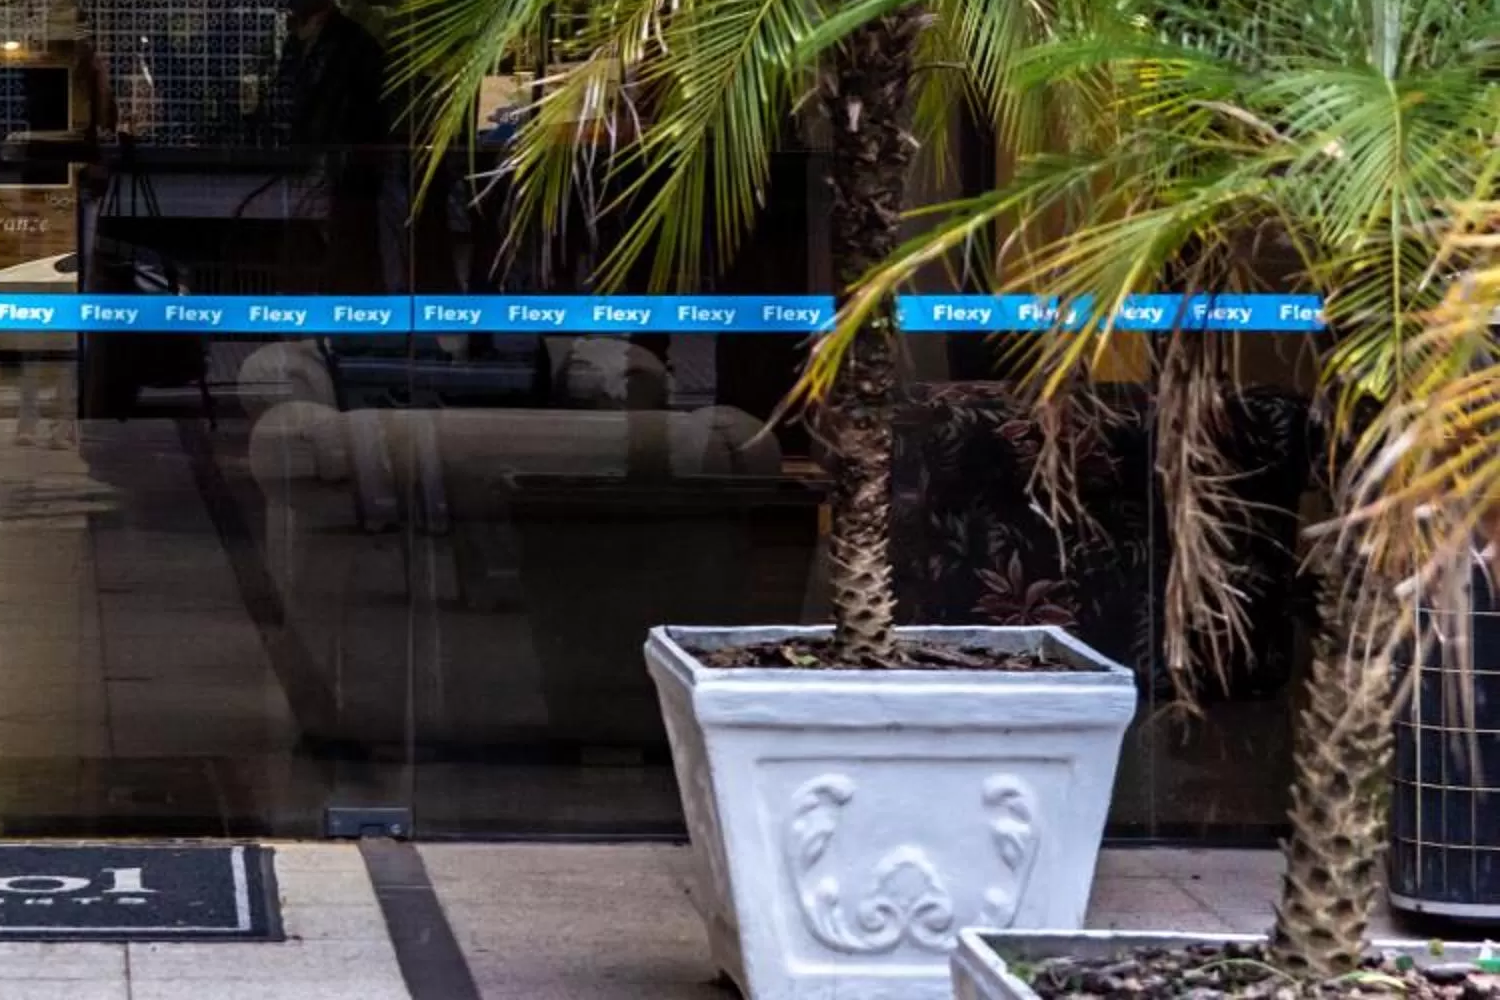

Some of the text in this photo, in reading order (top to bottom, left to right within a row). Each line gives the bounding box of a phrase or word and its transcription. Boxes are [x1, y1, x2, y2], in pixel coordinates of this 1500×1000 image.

[81, 304, 139, 324] Flexy
[165, 305, 223, 325] Flexy
[250, 305, 307, 325] Flexy
[334, 305, 392, 325] Flexy
[424, 304, 482, 325] Flexy
[508, 304, 566, 325] Flexy
[593, 305, 651, 325] Flexy
[678, 304, 736, 325] Flexy
[763, 305, 821, 325] Flexy
[933, 303, 992, 325] Flexy
